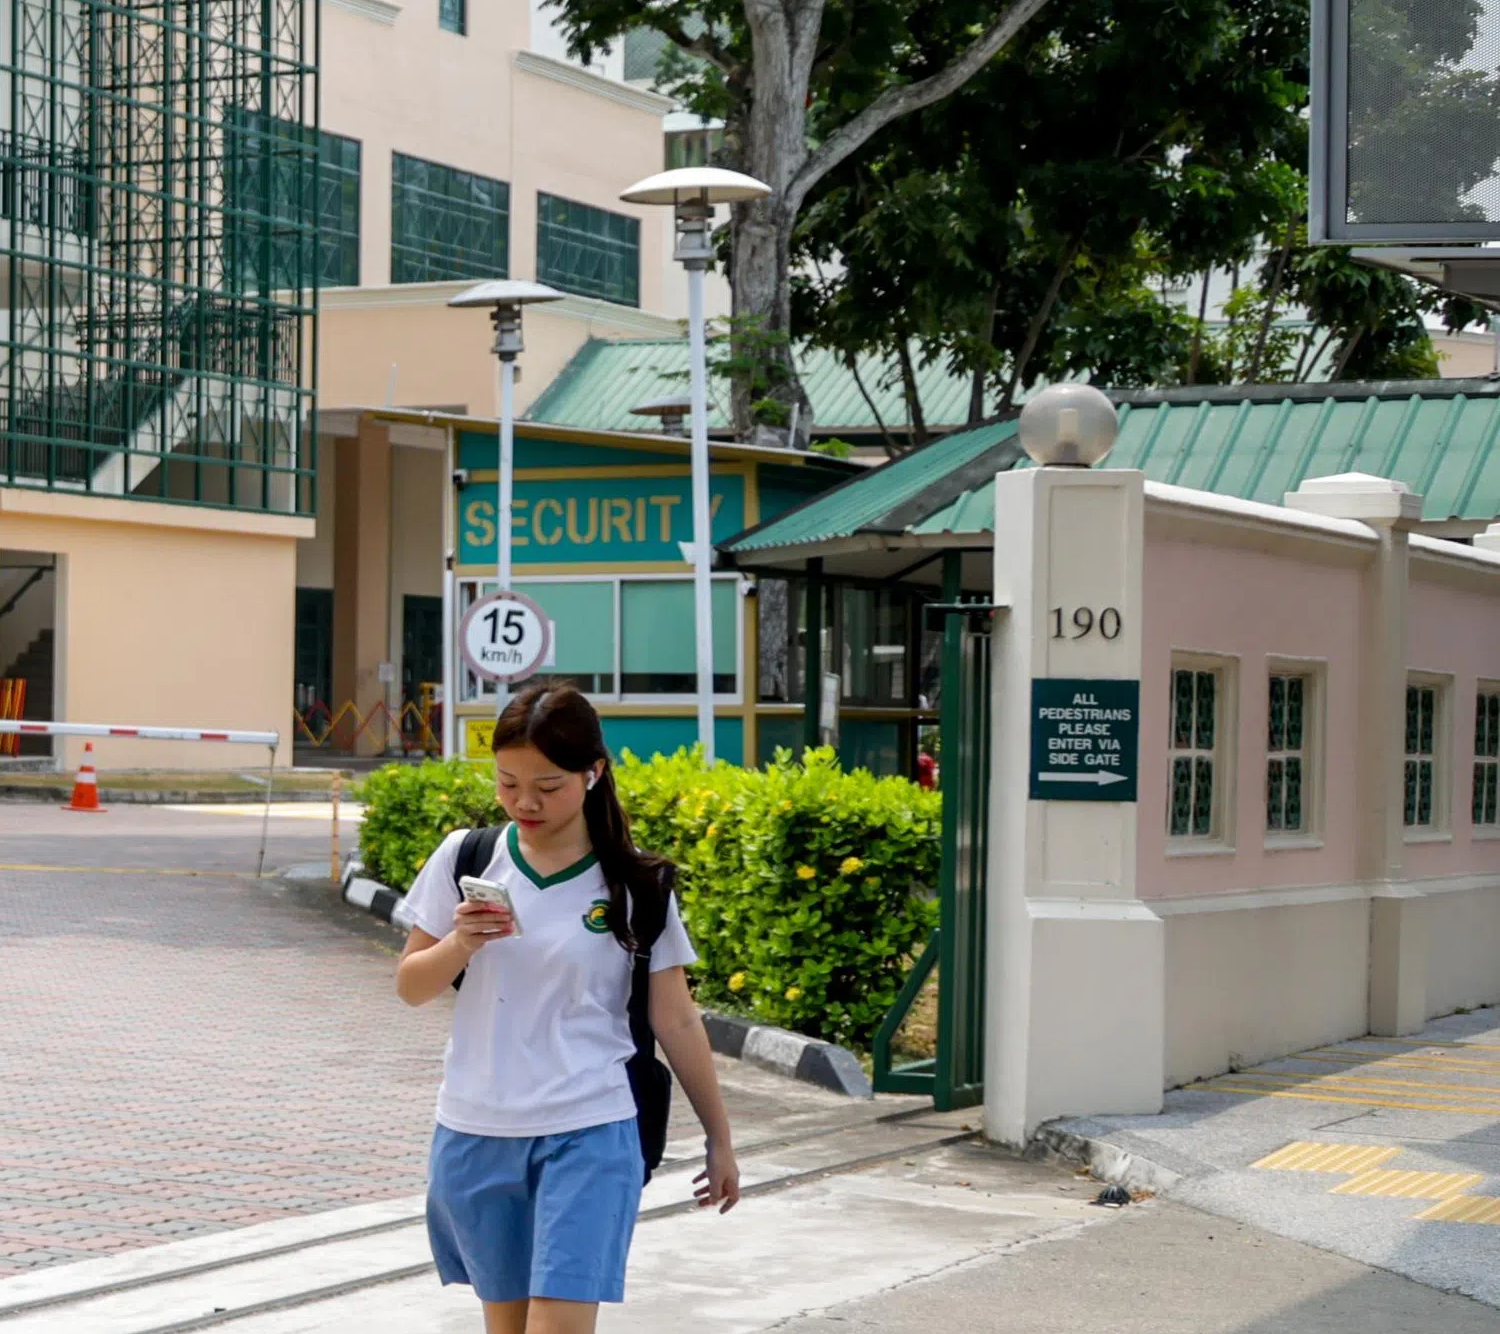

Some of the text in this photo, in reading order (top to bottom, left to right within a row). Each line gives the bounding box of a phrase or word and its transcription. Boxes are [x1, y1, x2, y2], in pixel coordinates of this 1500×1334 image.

[483, 608, 525, 645] 15
[1050, 605, 1122, 640] 190
[480, 646, 523, 665] km/h
[1072, 693, 1099, 705] ALL
[1038, 707, 1131, 721] PEDESTRIANS
[1058, 723, 1111, 736] PLEASE
[1048, 737, 1121, 751] ENTER VIA
[1048, 752, 1120, 766] SIDE GATE
